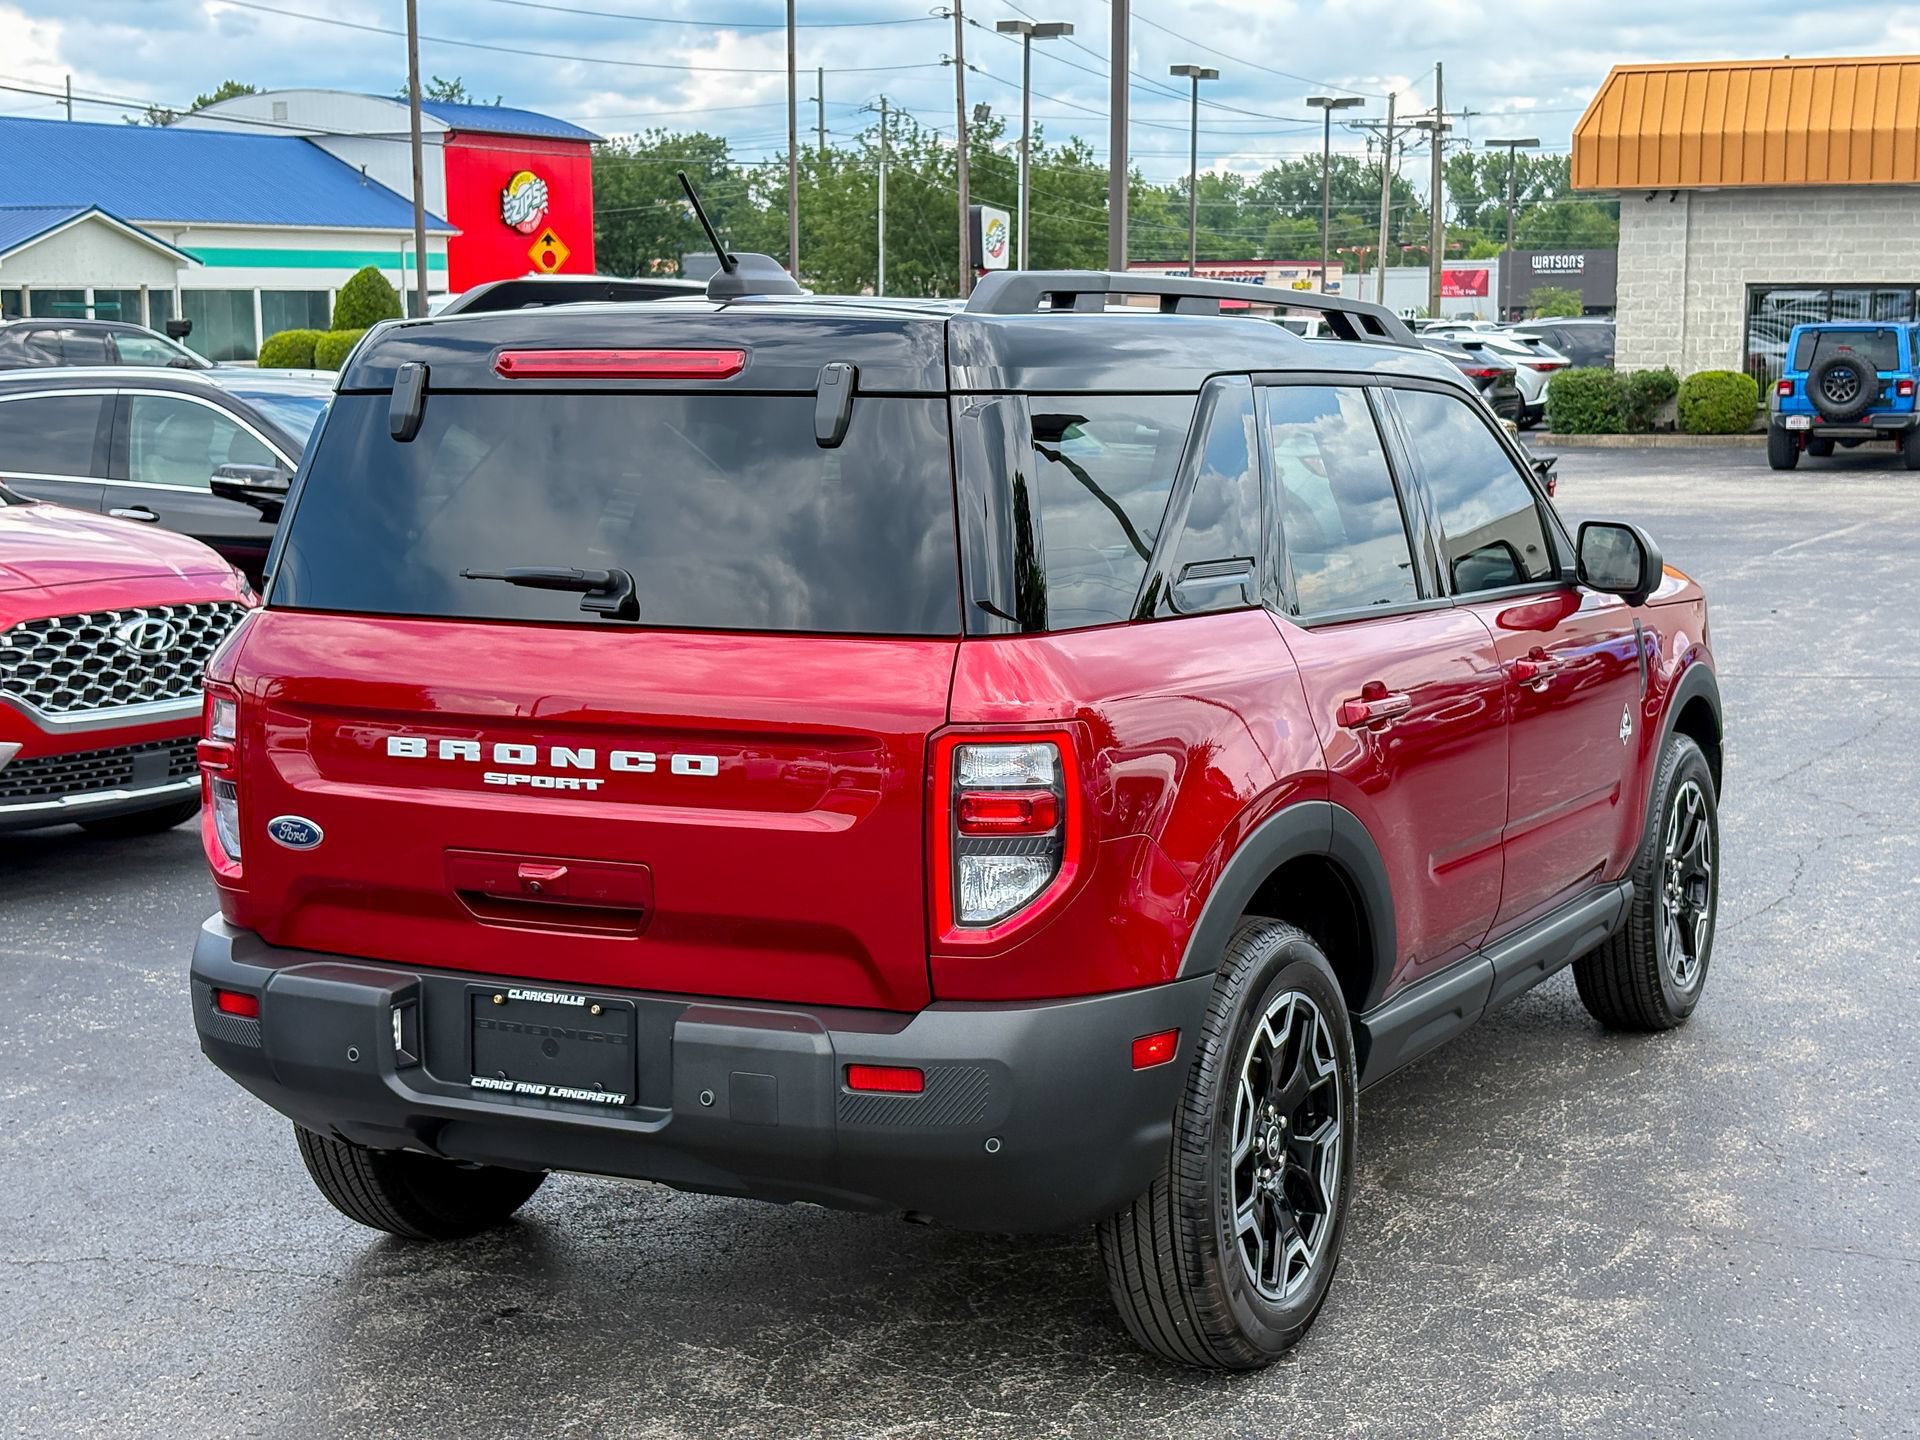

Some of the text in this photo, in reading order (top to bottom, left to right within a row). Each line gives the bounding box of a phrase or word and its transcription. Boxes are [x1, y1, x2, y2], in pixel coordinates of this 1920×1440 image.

[510, 182, 542, 222] ZIPS
[1532, 255, 1584, 268] WATSON'S
[386, 735, 720, 777] BRONCO
[483, 771, 605, 791] SPORT
[278, 821, 309, 842] Ford
[507, 989, 586, 1006] CLARKSVILLE
[475, 1017, 629, 1045] BRONCO
[470, 1077, 627, 1105] CRAIG AND LANDRETH
